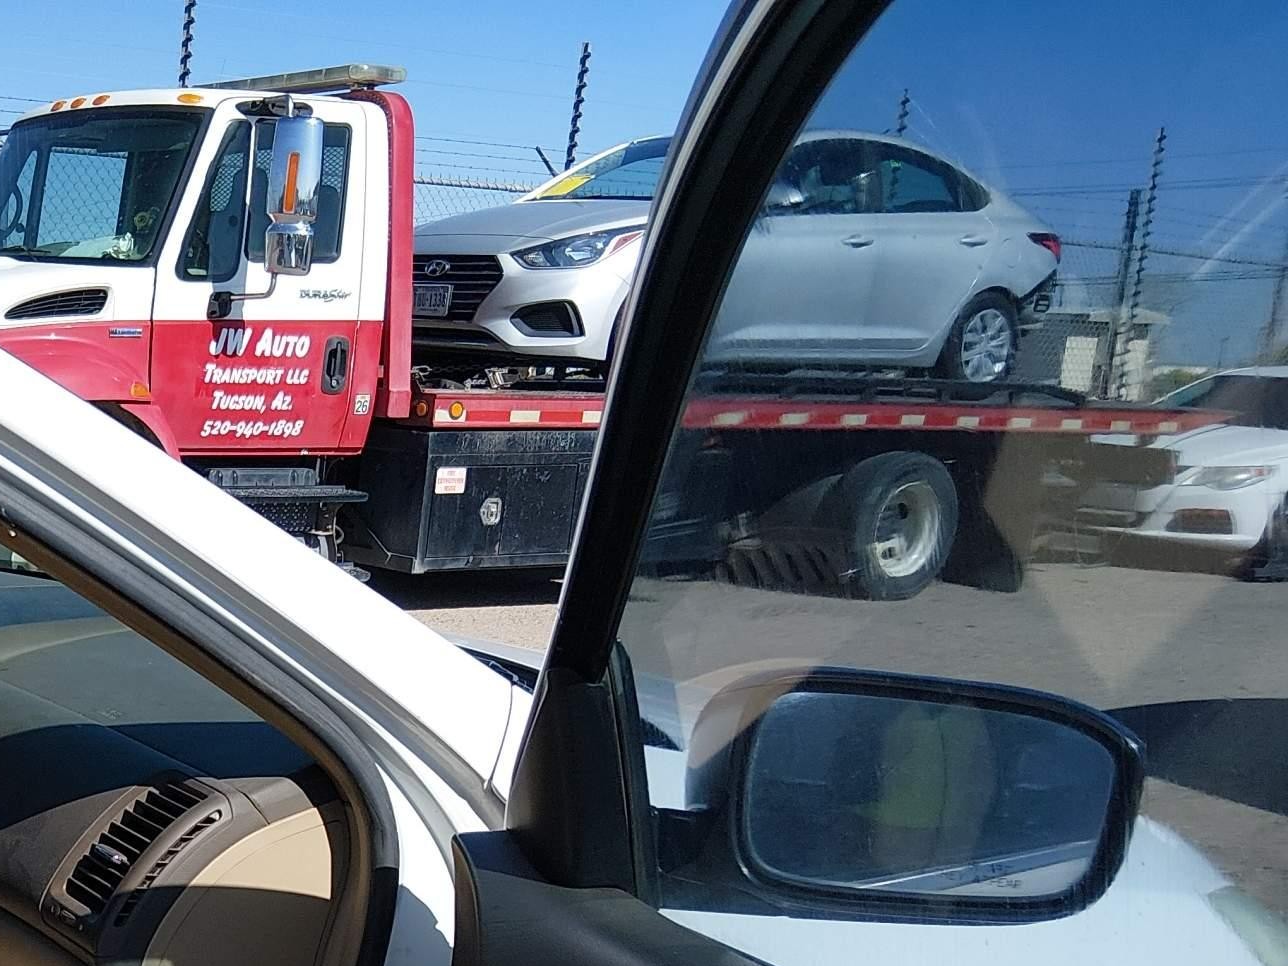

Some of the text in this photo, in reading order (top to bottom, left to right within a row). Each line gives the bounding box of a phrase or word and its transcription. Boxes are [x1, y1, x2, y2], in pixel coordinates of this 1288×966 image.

[209, 327, 252, 356] JW
[355, 399, 369, 413] 26
[200, 419, 305, 438] 520-940-1898
